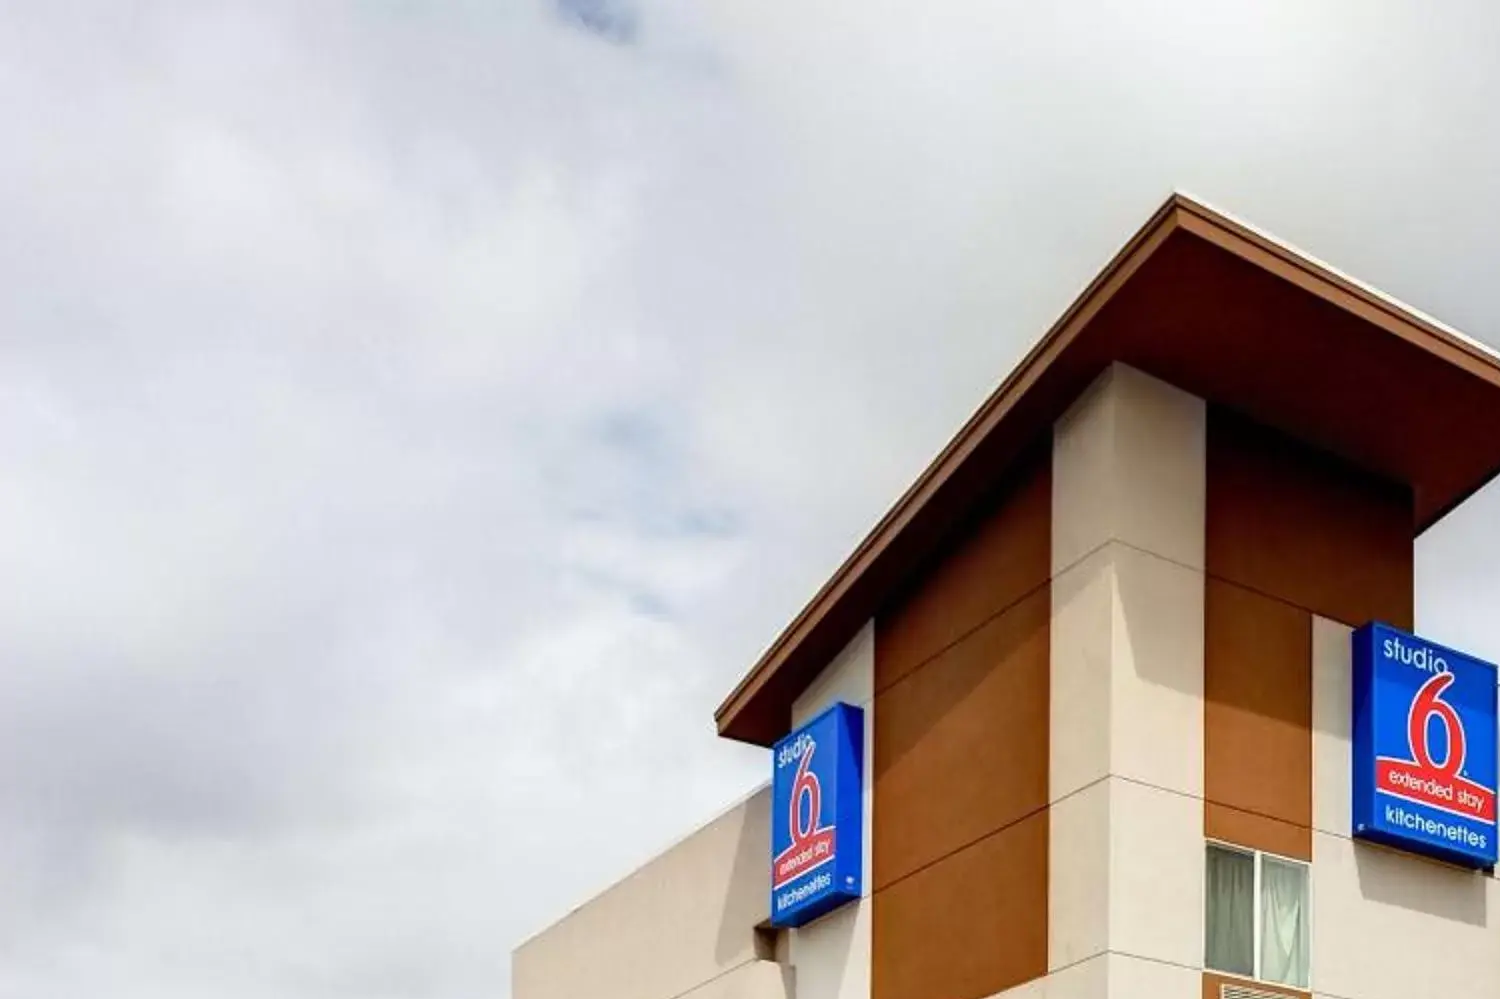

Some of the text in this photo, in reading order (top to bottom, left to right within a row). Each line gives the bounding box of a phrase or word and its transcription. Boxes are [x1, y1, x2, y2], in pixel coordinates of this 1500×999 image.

[1383, 637, 1448, 673] studio
[1407, 671, 1467, 777] 6
[778, 733, 813, 768] studio
[789, 741, 821, 846] 6
[1388, 769, 1484, 813] extended stay
[1385, 804, 1487, 849] kitchenettes
[777, 873, 832, 912] kitchenettes
